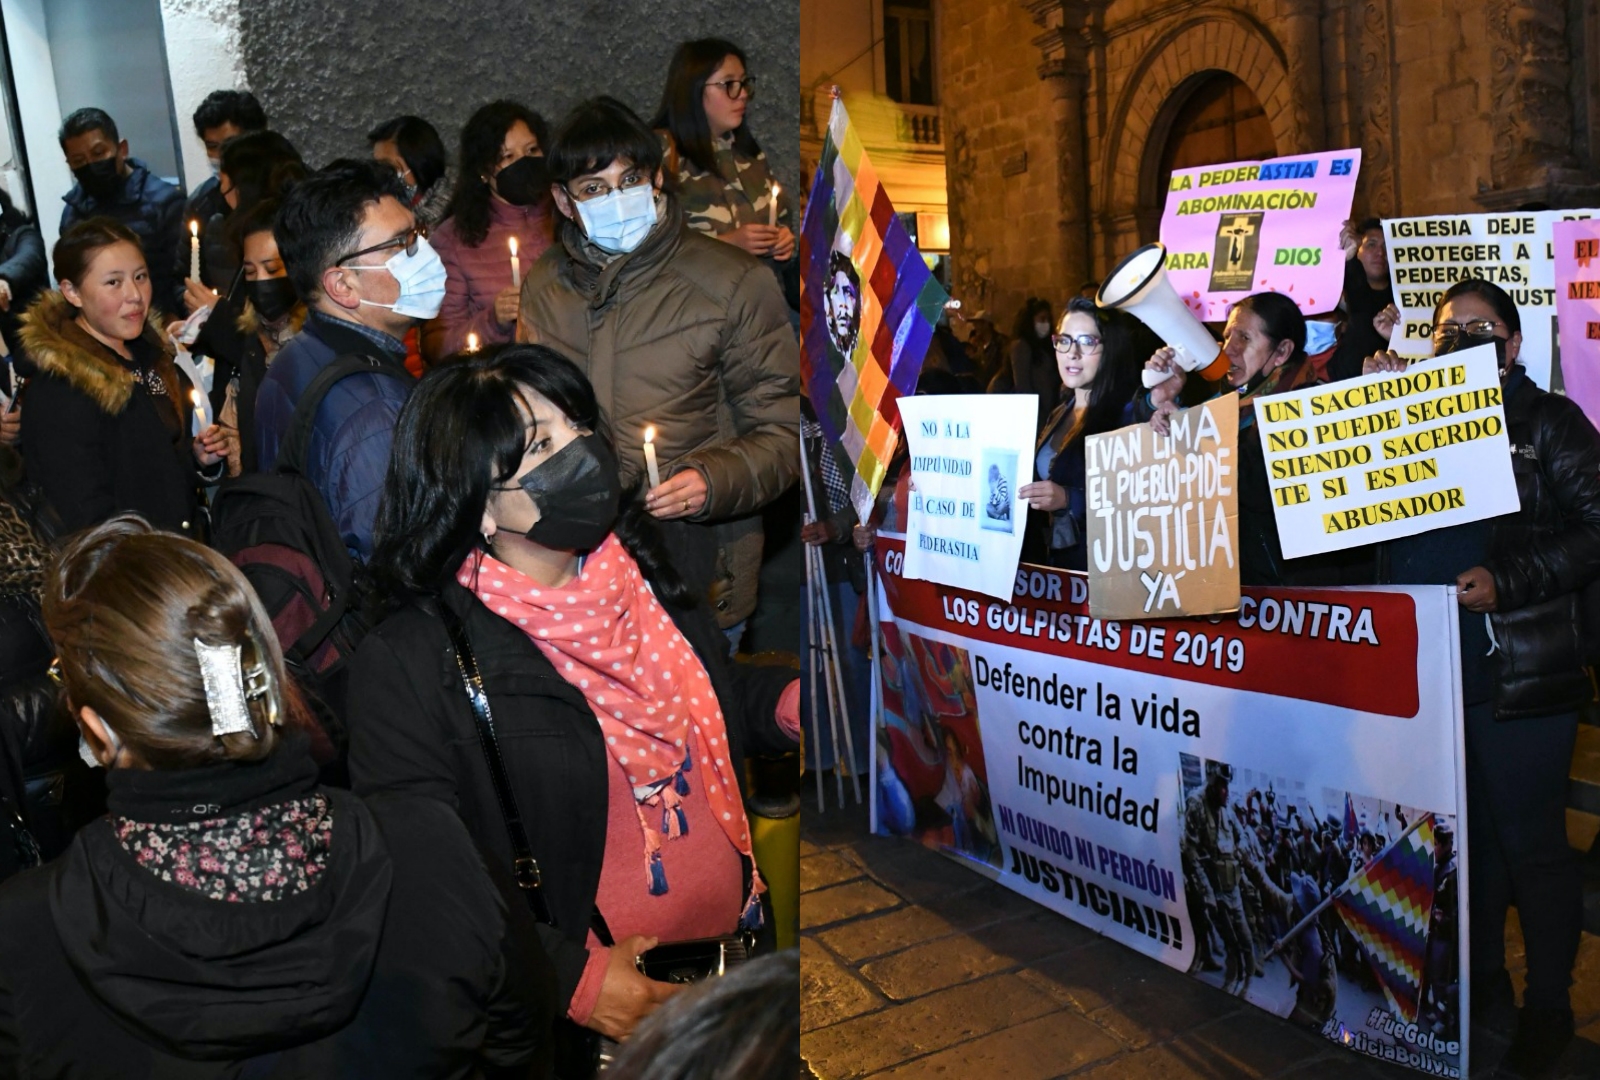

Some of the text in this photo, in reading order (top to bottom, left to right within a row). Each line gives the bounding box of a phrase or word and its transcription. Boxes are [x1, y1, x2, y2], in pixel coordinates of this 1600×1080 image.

[1170, 159, 1351, 191] LA PEDERASTIA ES
[1177, 190, 1317, 215] ABOMINACIÓN
[1391, 218, 1534, 237] IGLESIA DEJE
[1577, 240, 1598, 258] EL
[1275, 248, 1321, 265] DIOS
[1394, 245, 1500, 262] PROTEGER
[1517, 245, 1529, 259] A
[1396, 266, 1528, 285] PEDERASTAS,
[1264, 366, 1465, 422] UN SACERDOTE
[922, 422, 970, 438] NO A LA
[1086, 405, 1221, 476] IVAN LIMA
[1268, 387, 1502, 452] NO PUEDE SEGUIR
[914, 456, 971, 475] IMPUNIDAD
[1271, 416, 1501, 479] SIENDO SACERDO
[1089, 477, 1112, 510] EL
[1275, 459, 1437, 506] TE SI ES UN
[926, 499, 955, 515] CASO
[962, 502, 974, 517] DE
[1326, 488, 1465, 533] ABUSADOR
[1093, 500, 1234, 573] JUSTICIA
[1140, 570, 1186, 613] YÁ
[943, 595, 1244, 673] LOS GOLPISTAS DE 2019
[1239, 595, 1380, 646] CONTRA
[974, 655, 1201, 738] Defender la vida
[1018, 720, 1138, 775] contra la
[1018, 755, 1159, 833] Impunidad
[999, 804, 1177, 902] NI OLVIDO NI PERDÓN
[1011, 846, 1182, 951] JUSTICIA!!!
[1366, 1007, 1460, 1056] #FueGolpe
